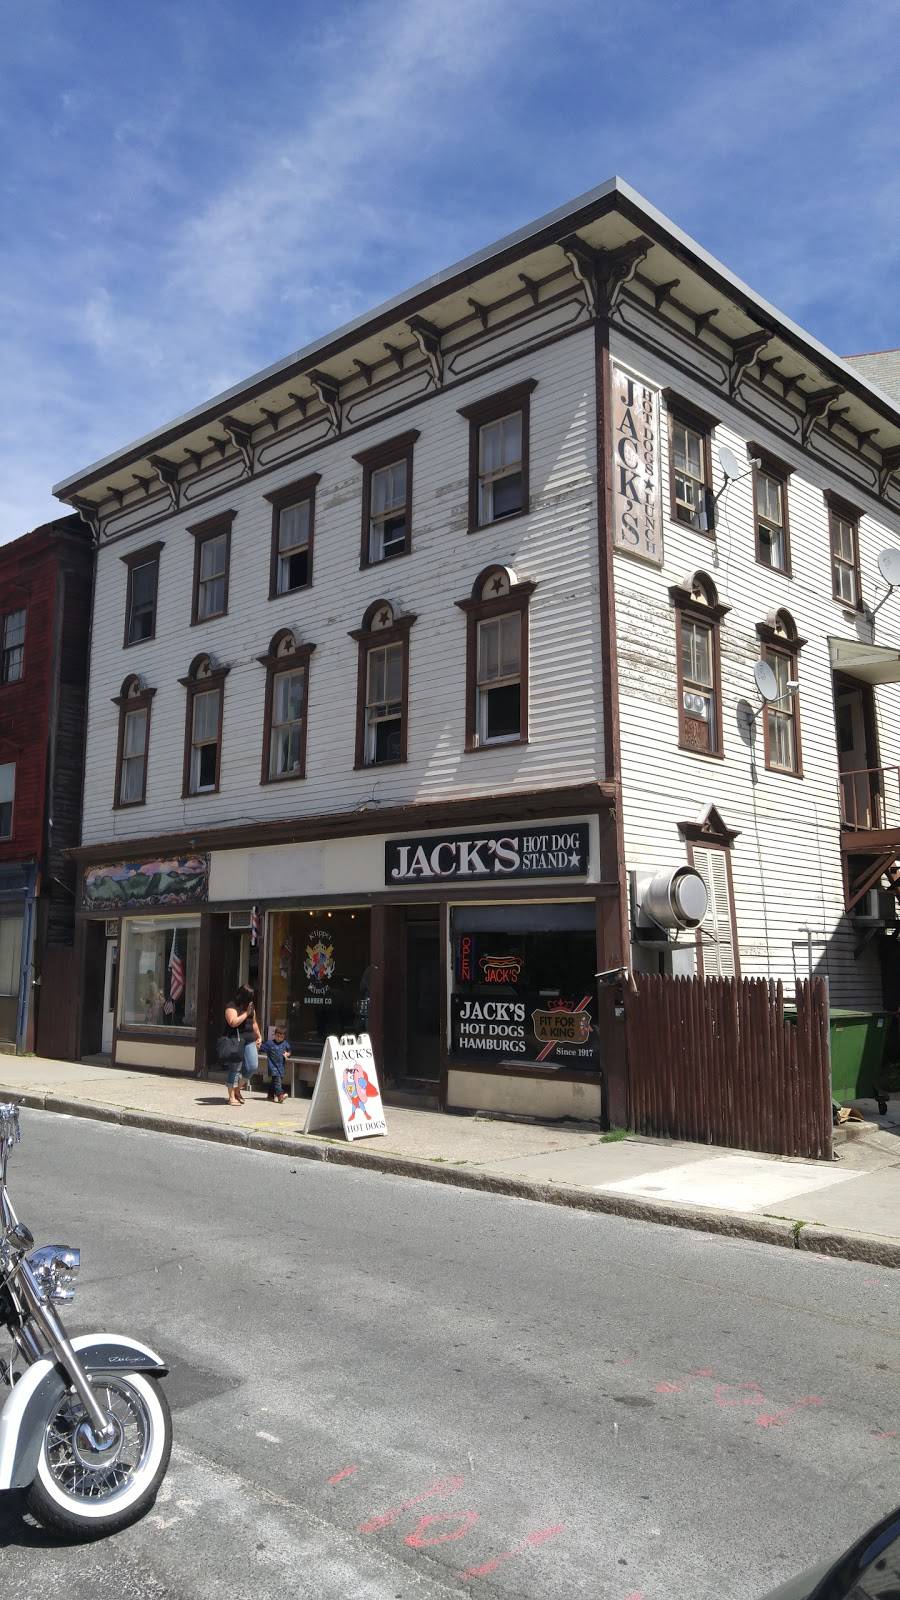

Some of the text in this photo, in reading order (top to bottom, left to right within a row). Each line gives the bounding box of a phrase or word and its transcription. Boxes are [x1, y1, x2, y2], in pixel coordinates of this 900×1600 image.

[615, 378, 641, 546] JACK'S
[642, 386, 656, 554] HOT DOGS LUNCH
[523, 833, 580, 852] HOT DOG
[391, 837, 520, 878] JACK'S
[522, 852, 568, 869] STAND
[462, 937, 471, 980] OPEN
[485, 969, 518, 982] JACK'S
[460, 1001, 525, 1022] JACK'S
[540, 1016, 575, 1027] FIT FOR
[460, 1023, 525, 1038] HOT DOGS
[540, 1027, 575, 1038] A KING
[459, 1037, 526, 1053] HAMBURGS
[556, 1047, 593, 1057] Since 1917
[334, 1048, 373, 1061] JACK'S
[347, 1120, 386, 1134] HOT DOGS
